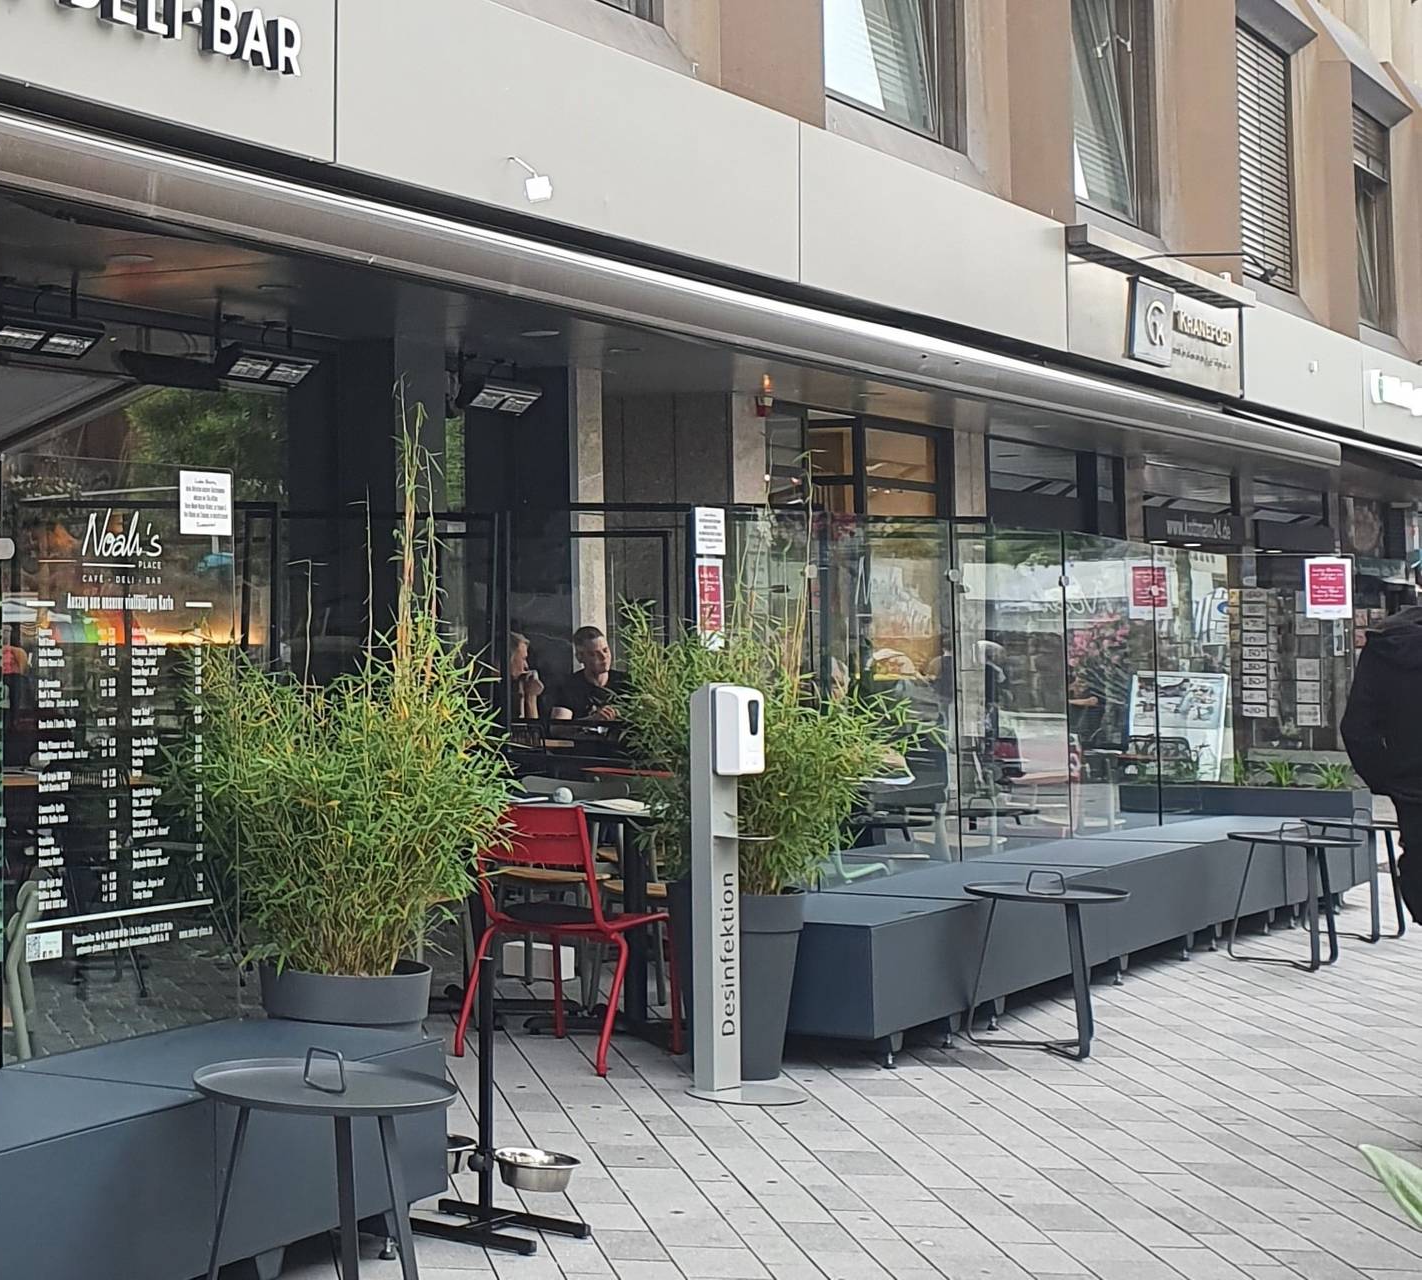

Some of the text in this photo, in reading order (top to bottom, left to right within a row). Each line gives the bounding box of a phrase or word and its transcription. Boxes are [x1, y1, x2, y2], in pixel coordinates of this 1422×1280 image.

[210, 0, 301, 76] BAR
[81, 507, 162, 557] Noah's
[82, 573, 162, 585] CAFÉ DELI BAR
[138, 560, 162, 570] PLACE
[720, 871, 736, 1037] Desinfektion
